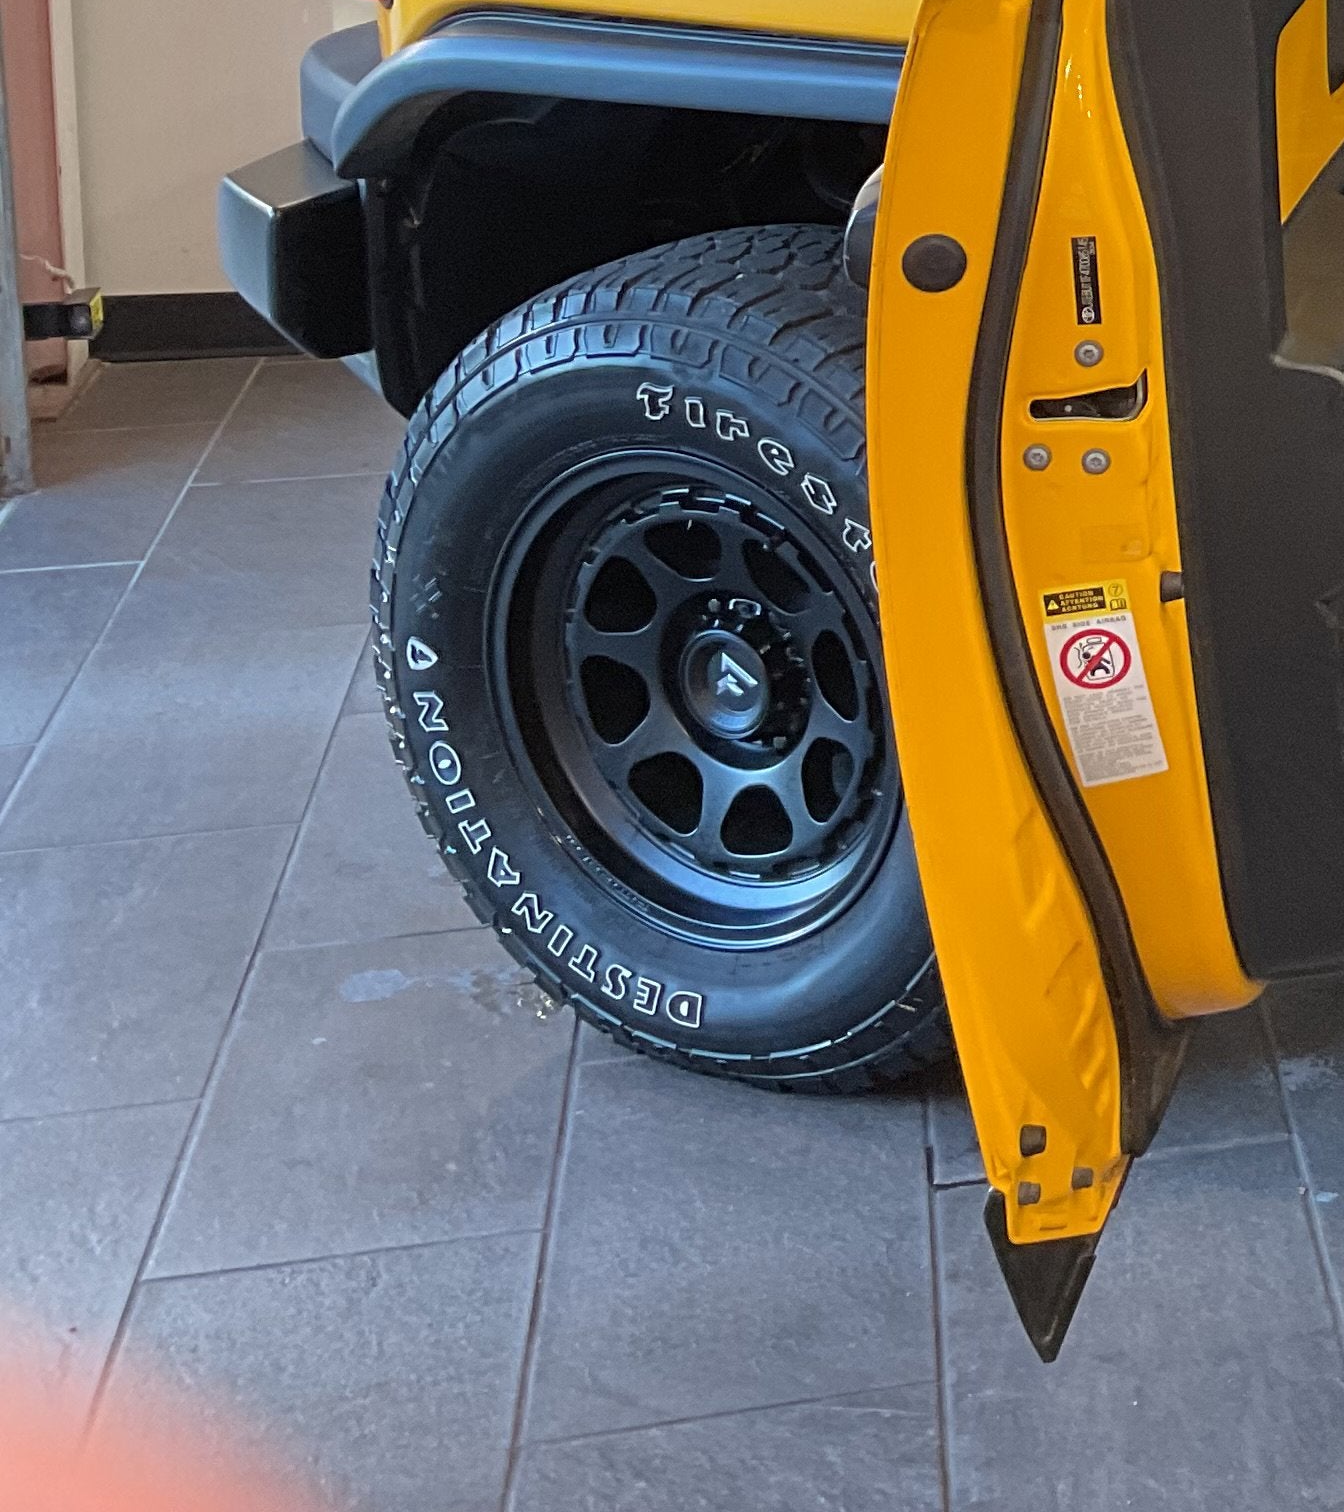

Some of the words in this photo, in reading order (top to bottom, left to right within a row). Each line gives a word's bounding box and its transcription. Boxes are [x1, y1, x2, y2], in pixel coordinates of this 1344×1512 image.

[636, 381, 880, 593] Firest
[1058, 589, 1095, 601] CAUTION
[1060, 595, 1104, 607] ATTENTION
[413, 689, 705, 1029] DESTINATION
